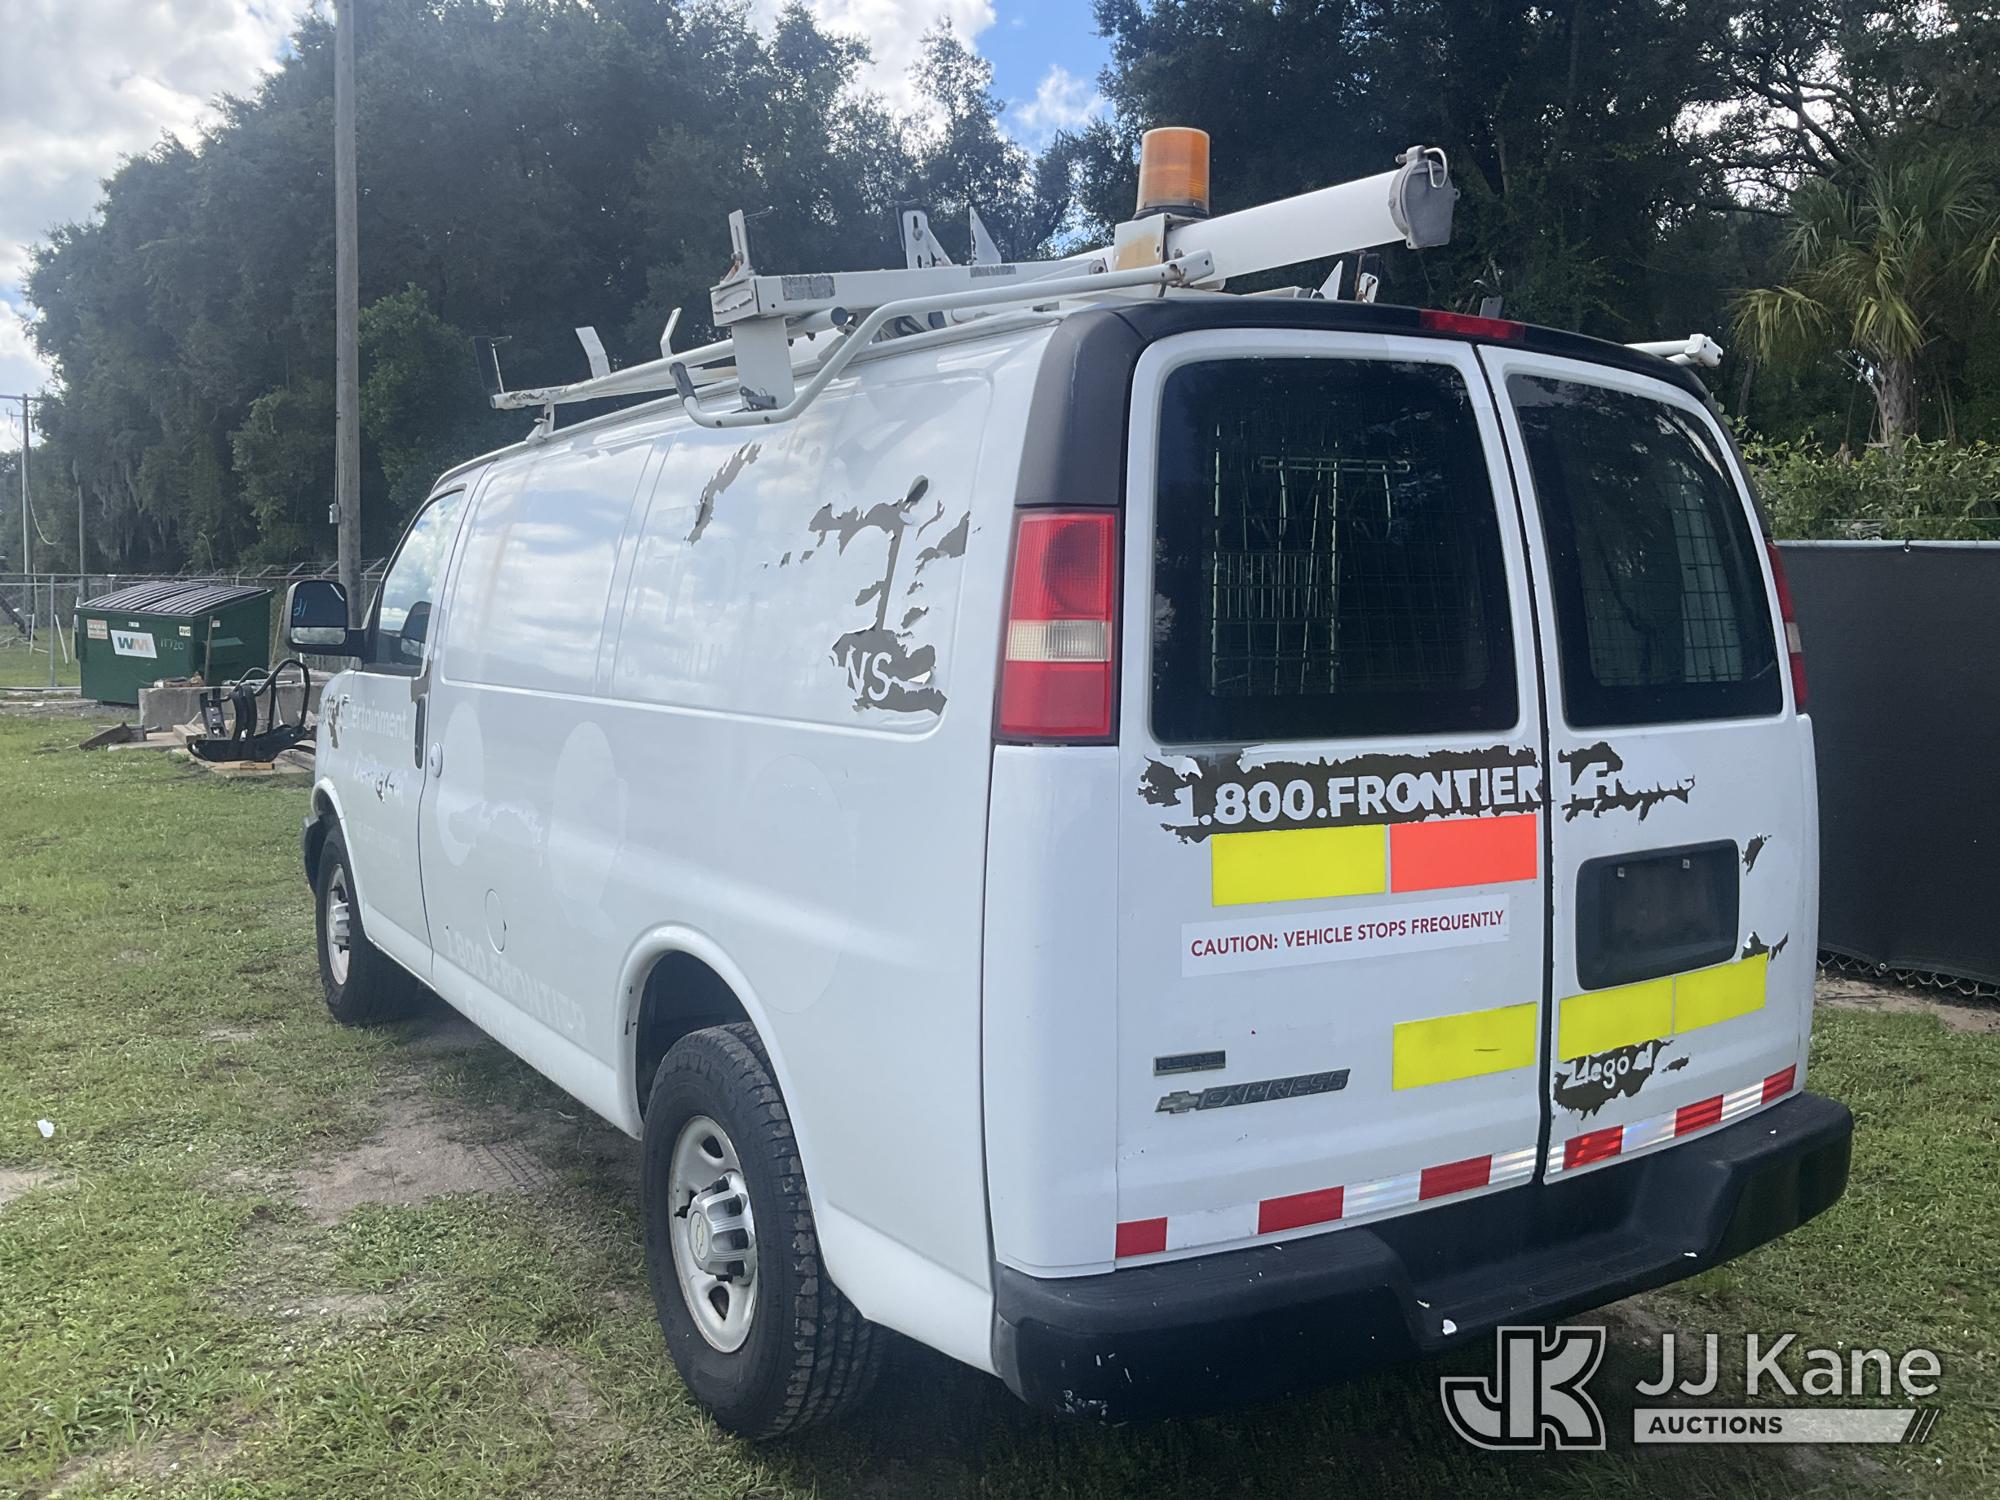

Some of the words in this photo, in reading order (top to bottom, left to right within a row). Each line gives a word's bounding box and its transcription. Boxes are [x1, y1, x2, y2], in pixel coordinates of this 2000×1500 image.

[117, 636, 151, 652] WM
[1178, 765, 1541, 827] 1.800.FRONTIER
[1191, 933, 1278, 957] CAUTION:
[1283, 926, 1353, 948] VEHICLE
[1357, 920, 1407, 941] STOPS
[1411, 910, 1505, 935] FREQUENTLY
[1201, 1070, 1349, 1110] EXPRESS
